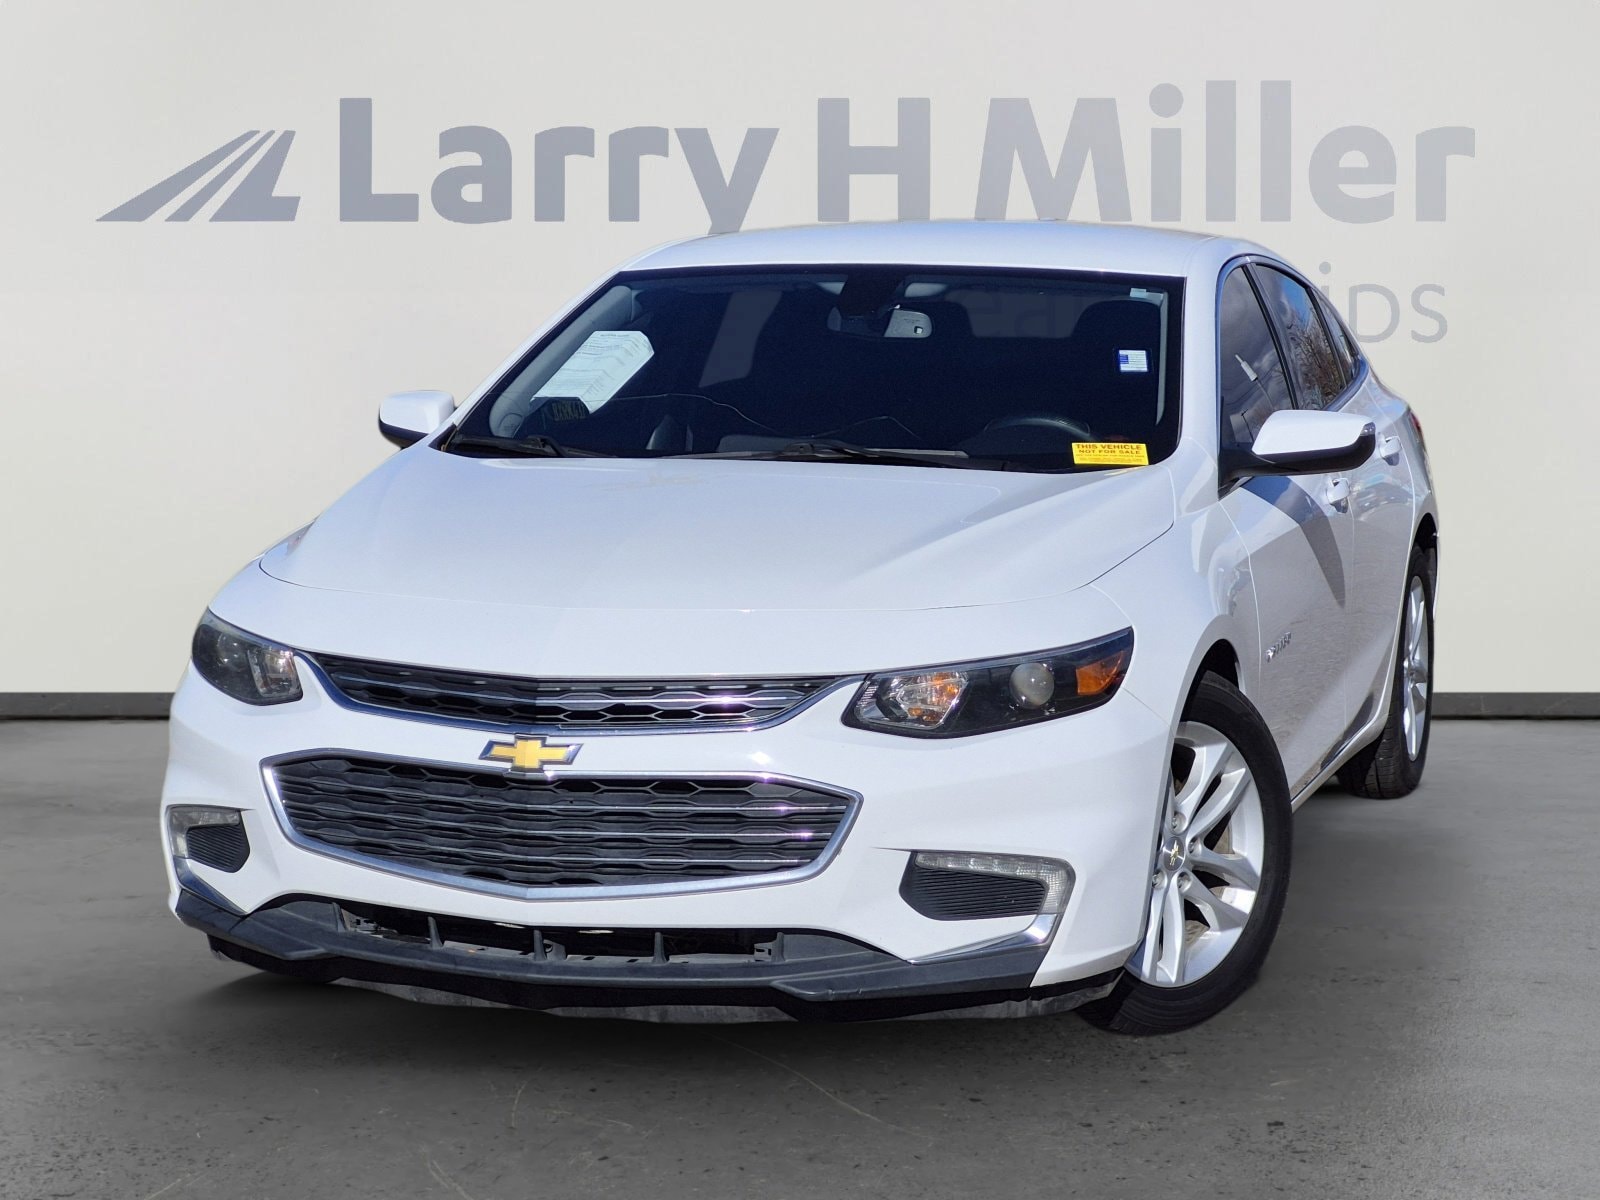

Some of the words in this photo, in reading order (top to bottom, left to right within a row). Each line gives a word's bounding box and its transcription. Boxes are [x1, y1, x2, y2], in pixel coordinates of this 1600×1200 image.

[339, 97, 780, 235] Larry
[817, 97, 931, 222] H
[974, 79, 1476, 224] Miller
